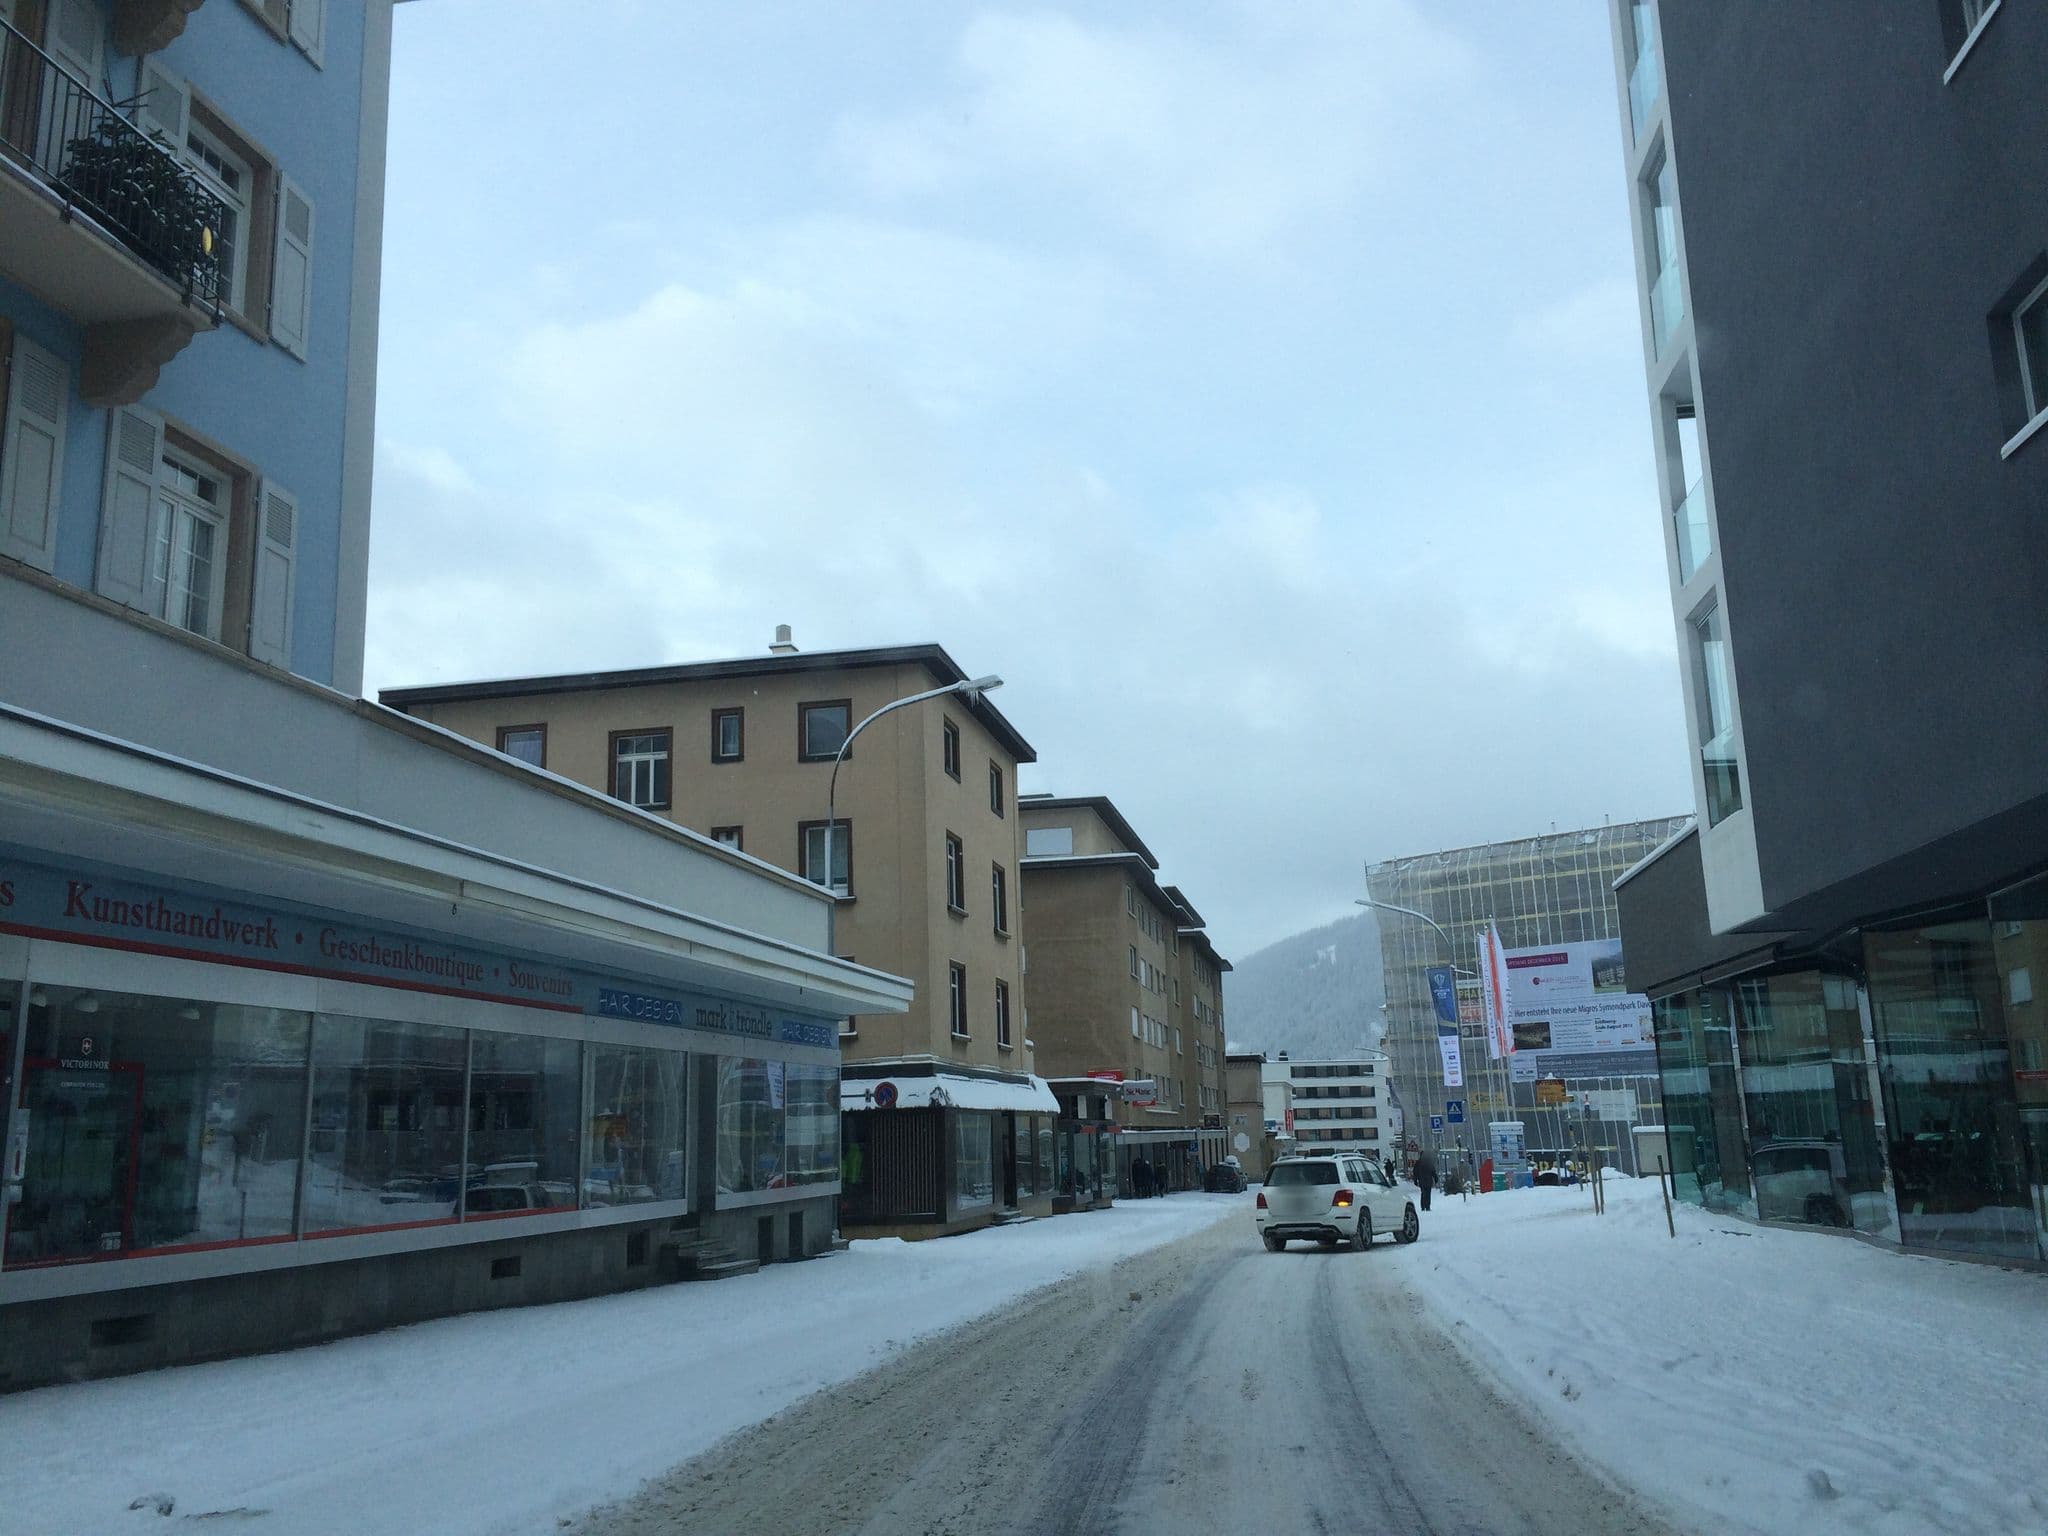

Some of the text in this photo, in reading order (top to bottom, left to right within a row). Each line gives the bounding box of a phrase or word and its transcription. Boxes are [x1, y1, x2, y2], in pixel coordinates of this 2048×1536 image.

[63, 880, 279, 949] Kunsthandwerk
[319, 927, 483, 985] Geschenkboutique
[508, 962, 574, 996] Souvenirs
[600, 991, 683, 1022] HAIR DESIGN
[696, 1003, 727, 1029] mark
[1514, 1008, 1525, 1017] Hier
[1526, 1007, 1550, 1017] entsteht
[1578, 1004, 1598, 1014] Migros
[781, 1025, 832, 1045] HAIR DESIGN
[61, 1058, 109, 1071] VICTORINOX
[1433, 1118, 1441, 1128] P
